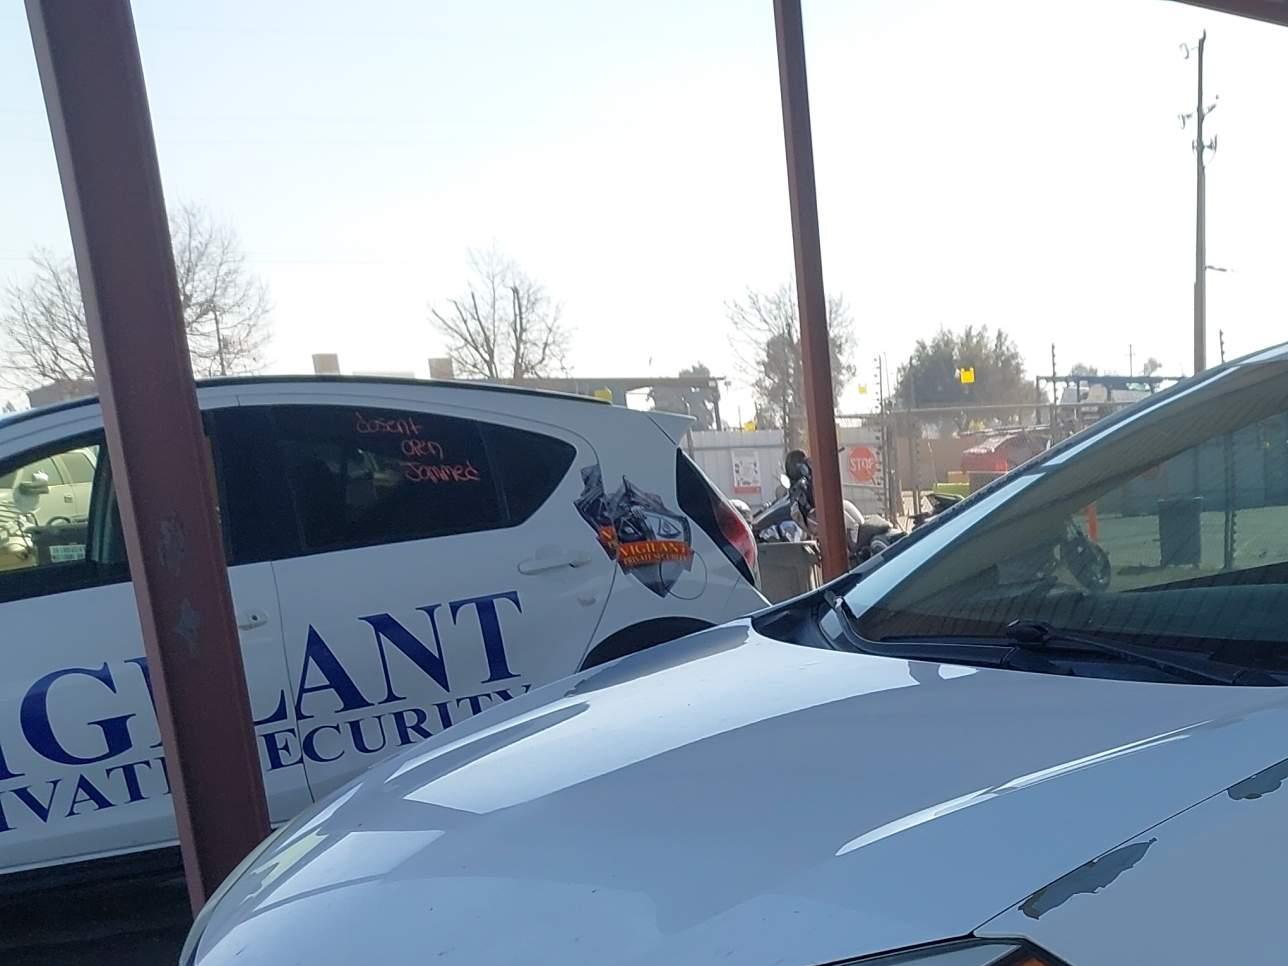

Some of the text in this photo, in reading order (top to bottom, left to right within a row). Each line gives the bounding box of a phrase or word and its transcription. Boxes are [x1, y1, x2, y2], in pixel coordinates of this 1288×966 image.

[850, 456, 873, 472] STOP
[0, 591, 523, 780] GANT
[258, 684, 531, 771] ECURIT
